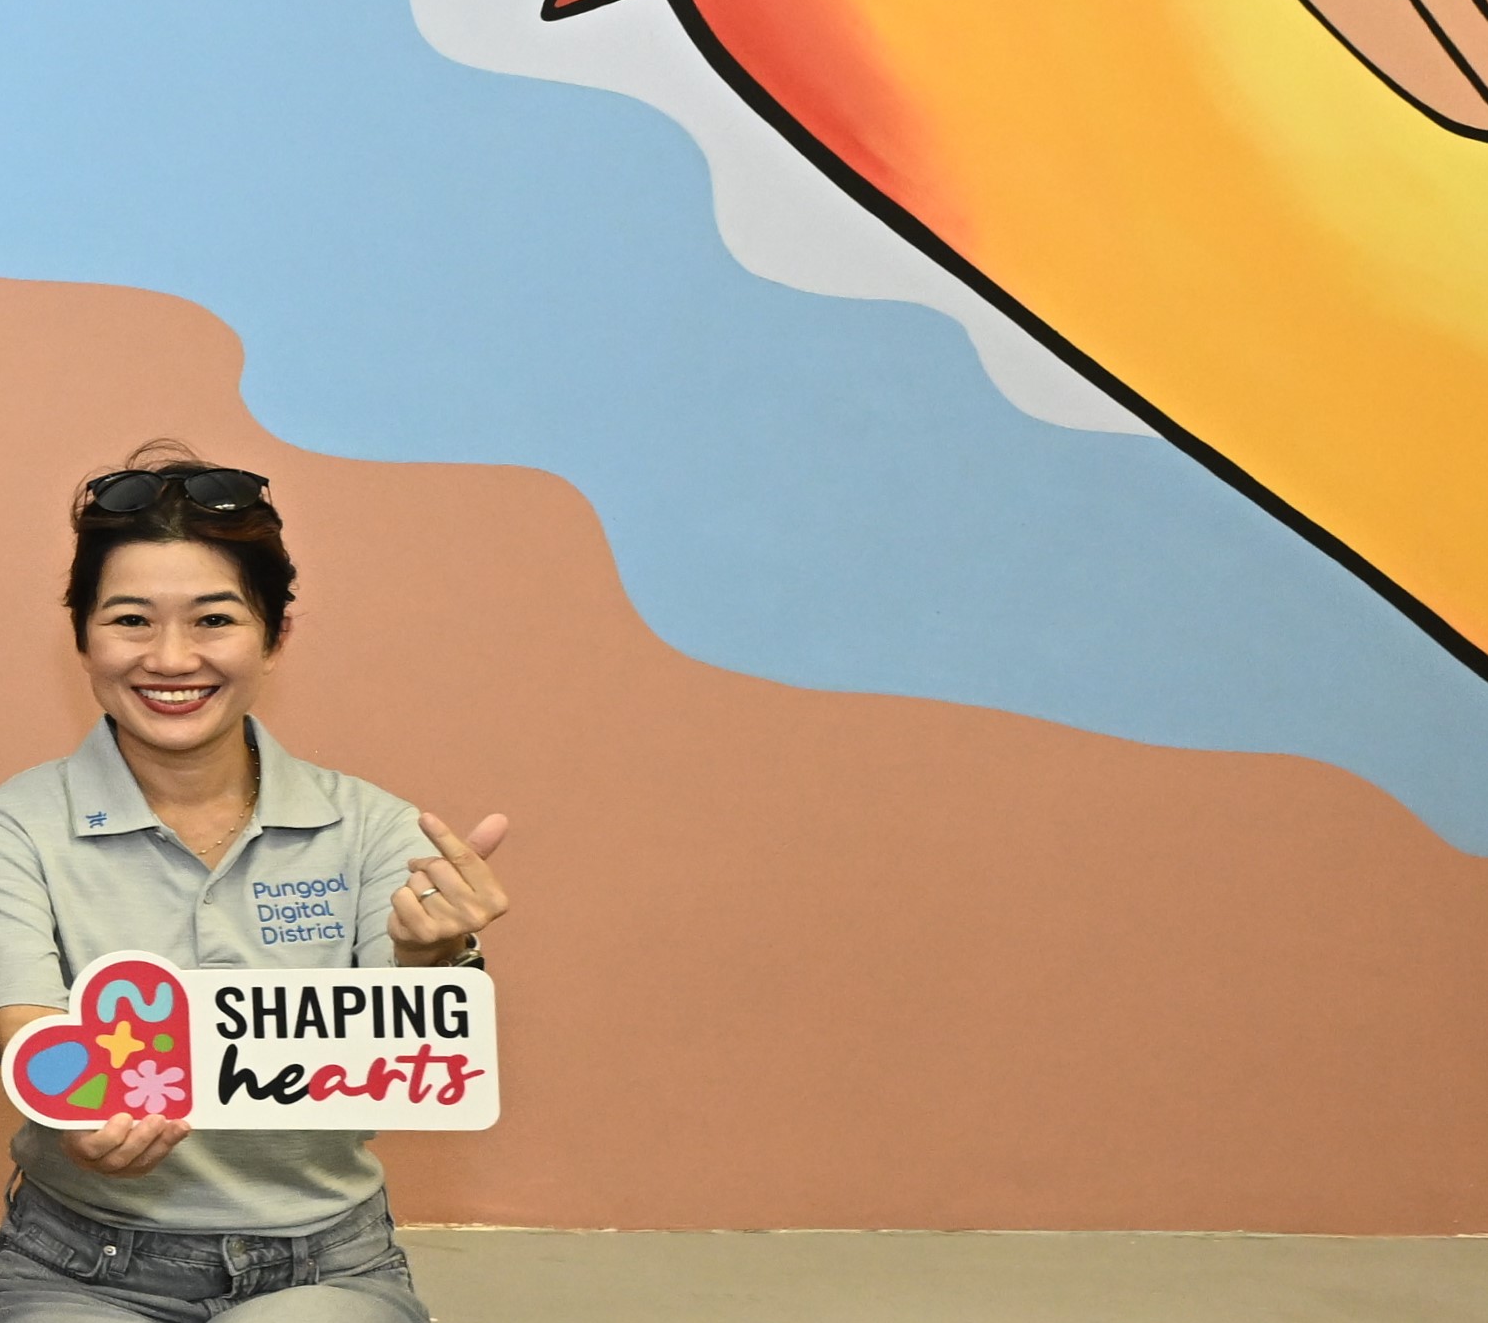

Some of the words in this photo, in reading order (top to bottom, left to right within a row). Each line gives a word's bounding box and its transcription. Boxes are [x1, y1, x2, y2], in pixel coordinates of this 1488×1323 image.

[253, 873, 349, 899] Punggol
[257, 900, 335, 924] Digital
[261, 922, 345, 945] District
[214, 984, 470, 1041] SHAPING
[217, 1043, 486, 1106] hearts
